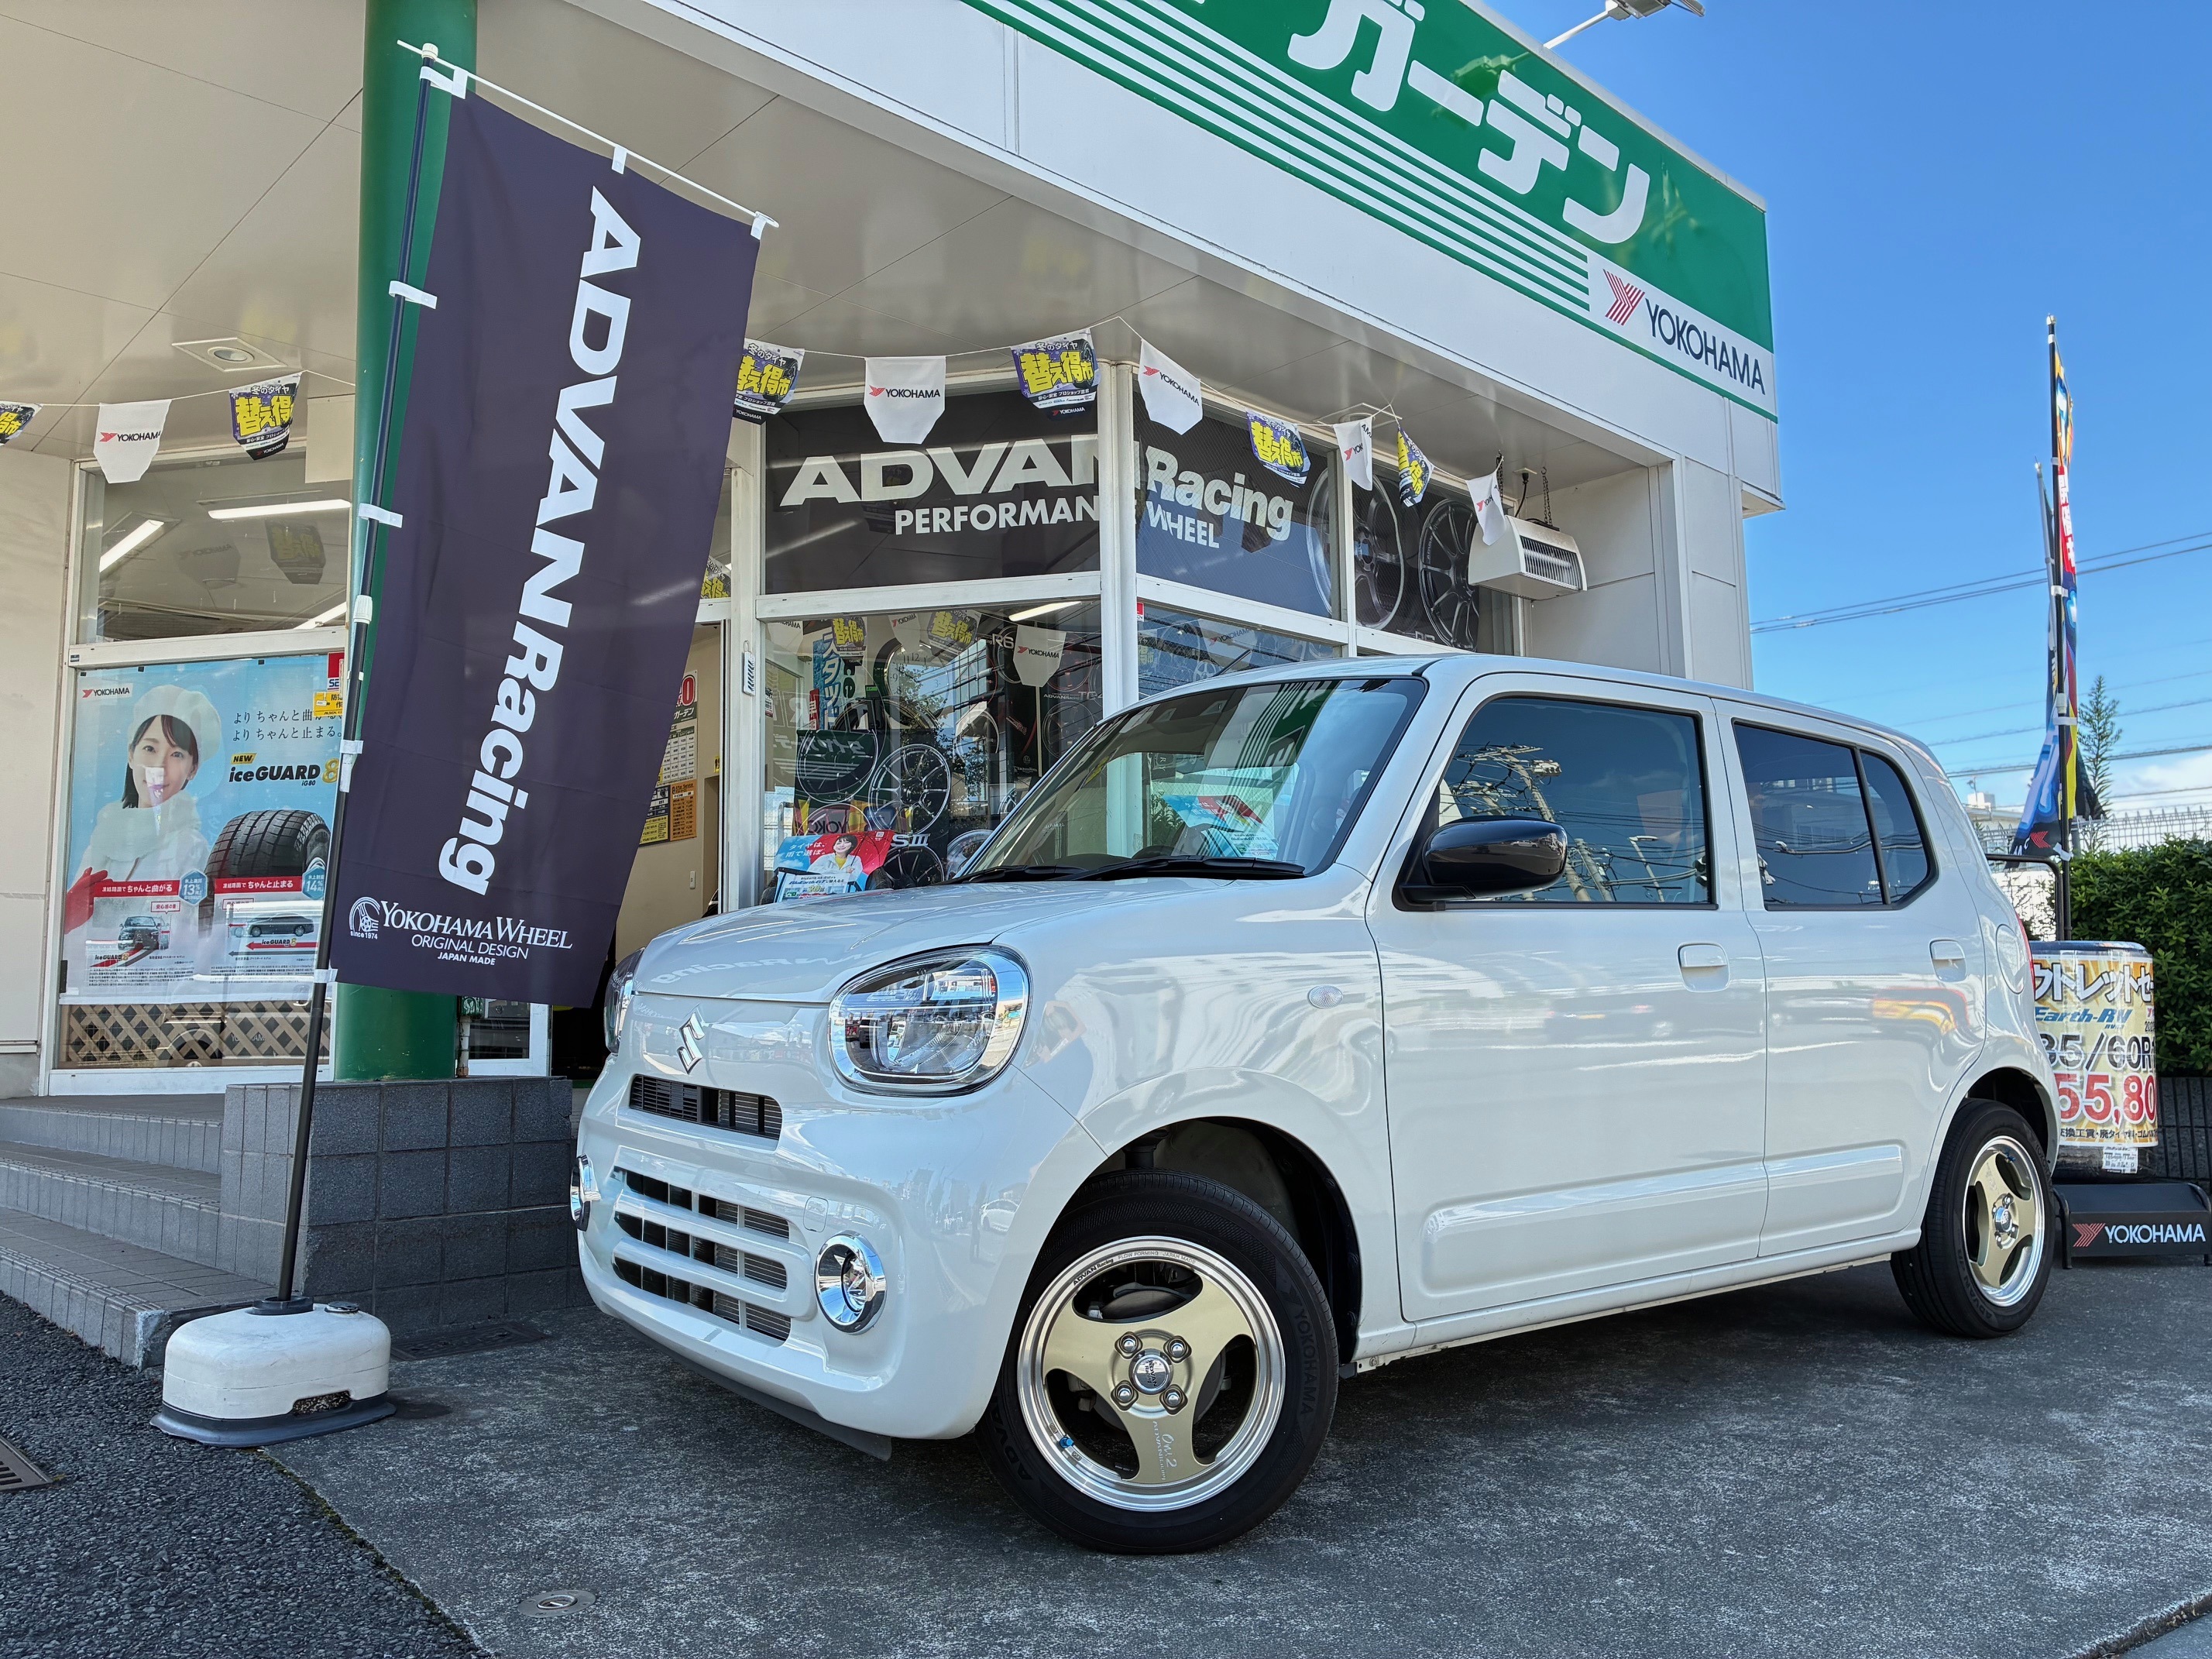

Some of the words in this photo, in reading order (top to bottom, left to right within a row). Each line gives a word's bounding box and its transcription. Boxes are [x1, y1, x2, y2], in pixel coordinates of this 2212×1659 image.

[1646, 298, 1765, 395] YOKOHAMA
[1020, 352, 1095, 393] 替え得市
[885, 388, 941, 399] YOKOHAMA
[1159, 372, 1200, 406] YOKOHAMA
[235, 395, 294, 437] 替え得
[519, 186, 641, 628] ADVAN
[736, 410, 762, 420] YOKOHAMA
[1251, 421, 1304, 467] 替え得市
[1146, 445, 1293, 541] Racing
[895, 496, 1100, 534] PERFORMAN
[1146, 501, 1220, 549] WHEEL
[1028, 648, 1060, 659] YOKOHAMA
[94, 687, 130, 696] YOKOHAMA
[229, 764, 320, 782] iceGUARD
[322, 758, 338, 783] 8
[439, 621, 564, 896] Racing
[127, 883, 173, 892] ちゃんと曲がる
[248, 880, 294, 889] ちゃんと止まる
[365, 932, 378, 940] 1974
[381, 900, 493, 940] YOKOHAMA
[496, 916, 573, 950] WHEEL
[411, 934, 475, 953] ORIGINAL
[478, 941, 529, 960] DESIGN
[438, 952, 467, 962] JAPAN
[469, 956, 496, 965] MADE
[2034, 963, 2154, 1002] ウトレットセ
[2104, 1224, 2206, 1243] YOKOHAMA
[1180, 1255, 1197, 1264] MADE
[1073, 1266, 1097, 1286] ADVAN
[1296, 1308, 1317, 1416] YOKOHAMA
